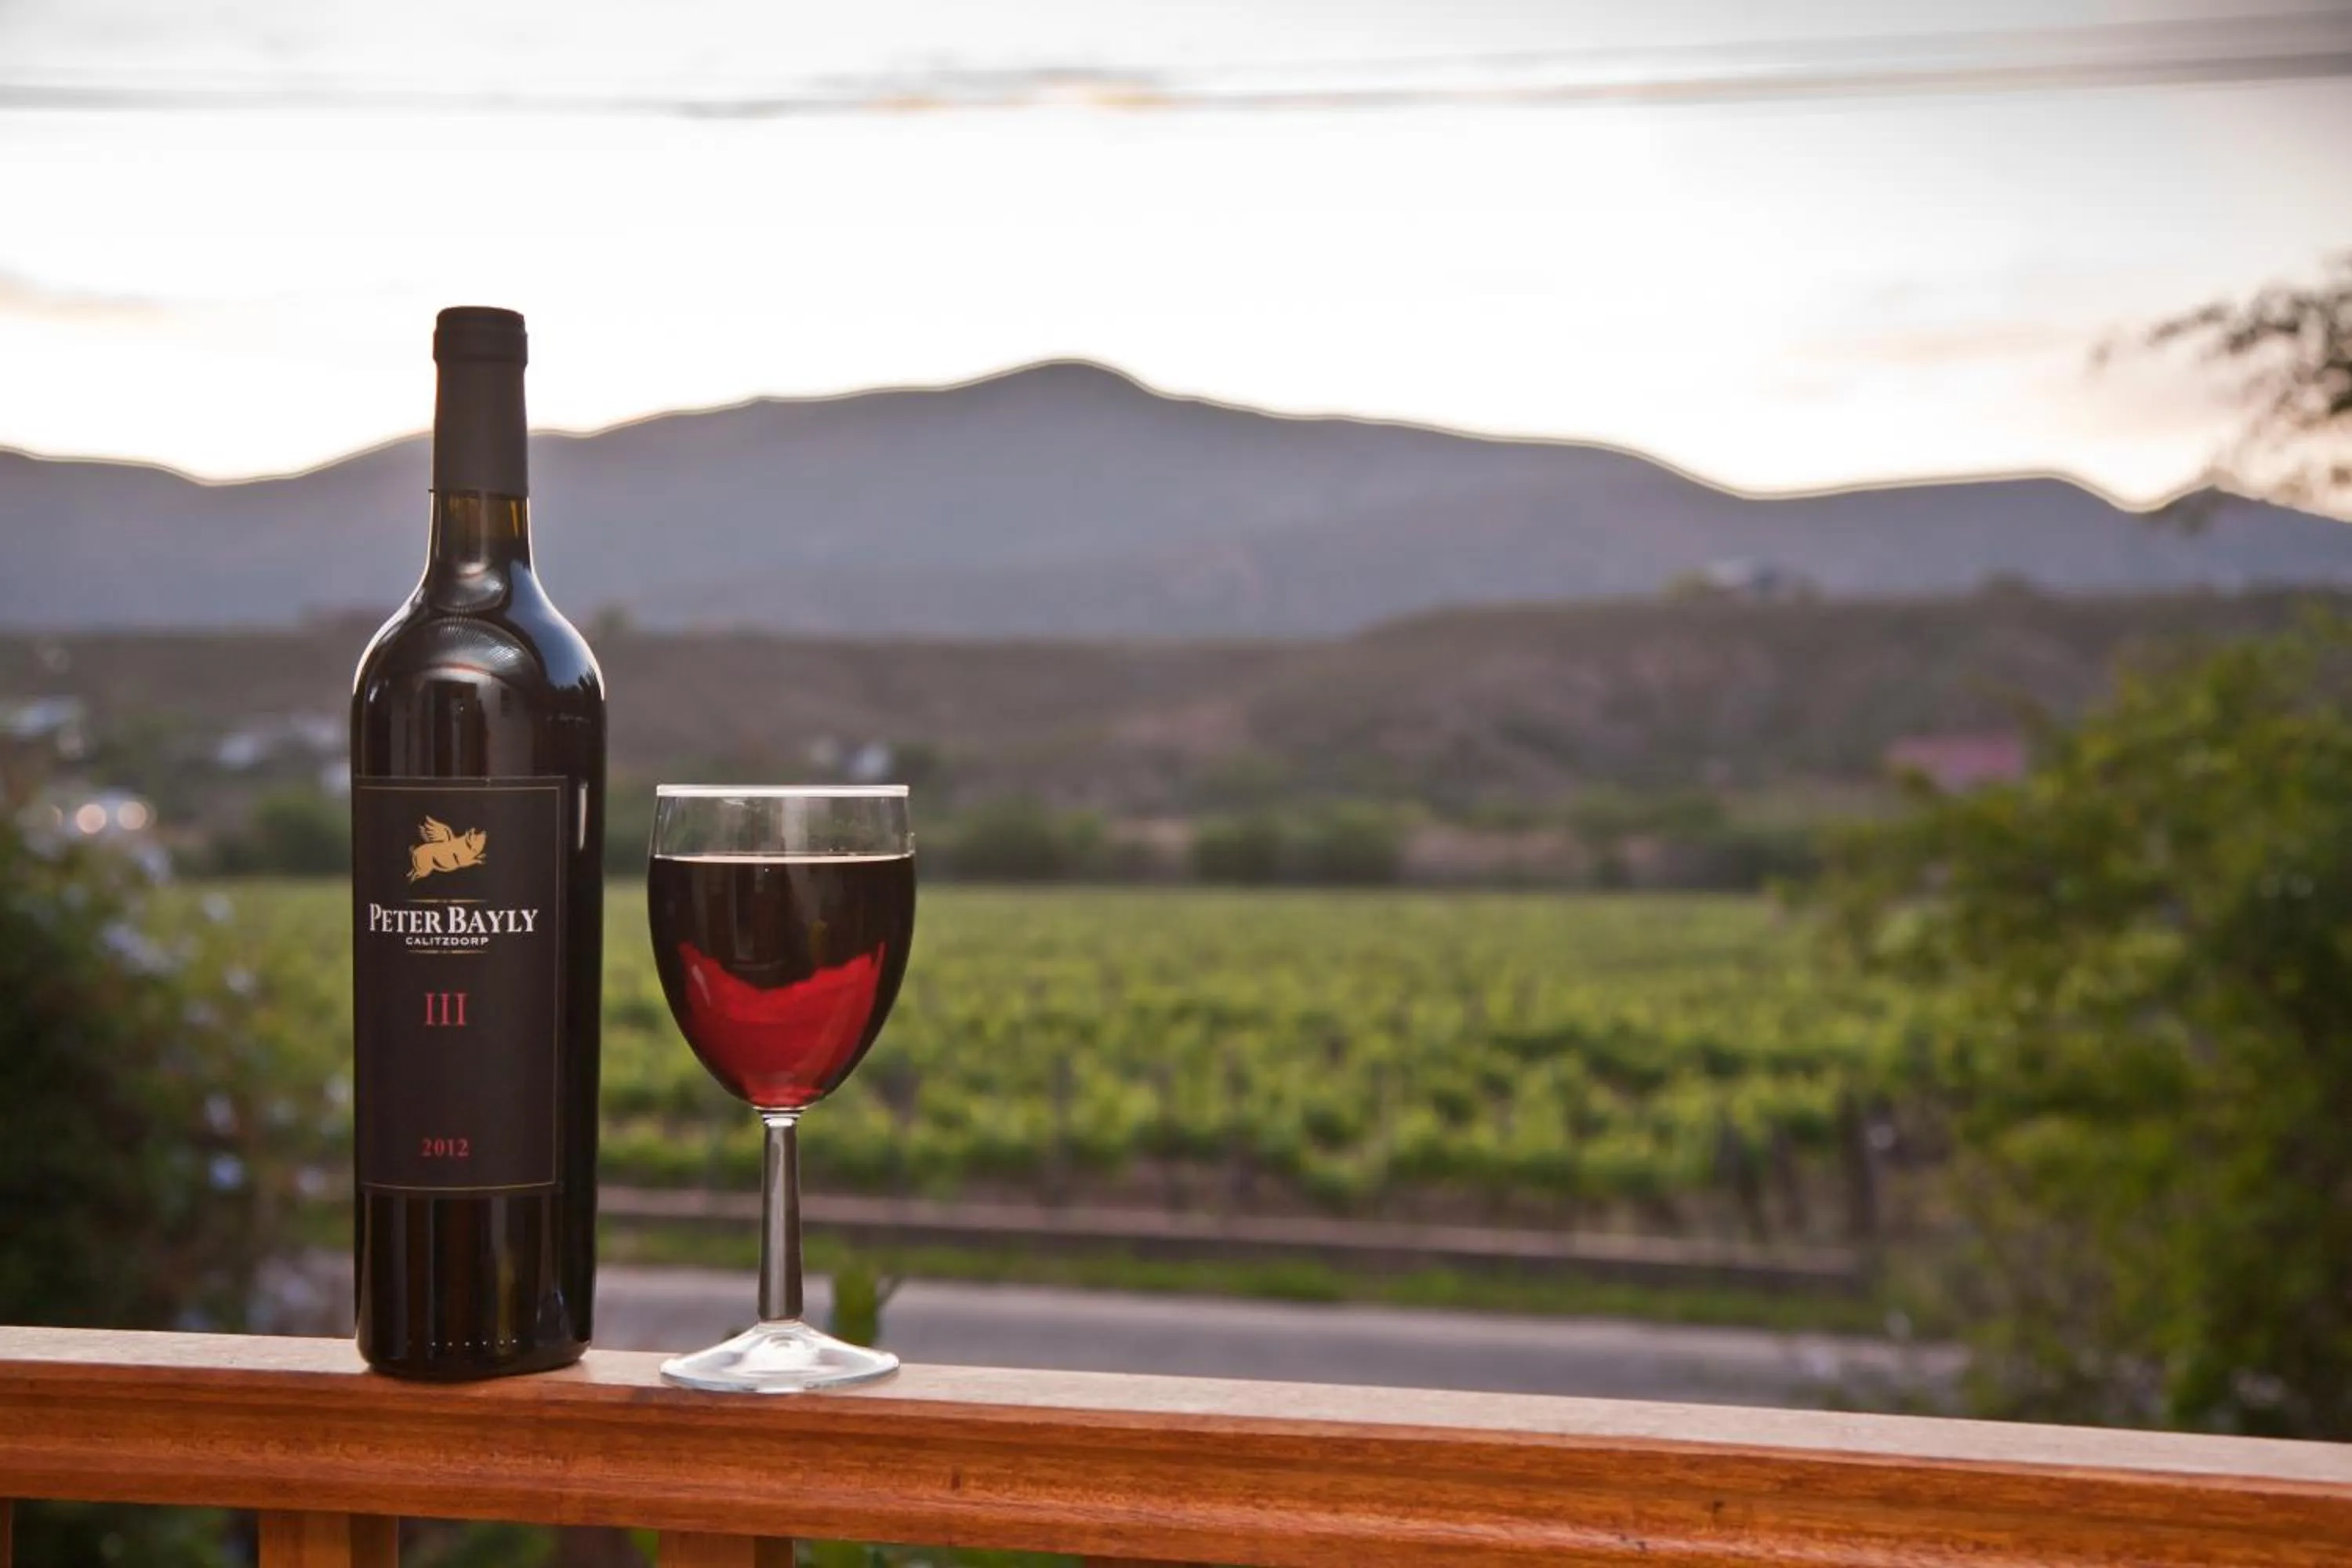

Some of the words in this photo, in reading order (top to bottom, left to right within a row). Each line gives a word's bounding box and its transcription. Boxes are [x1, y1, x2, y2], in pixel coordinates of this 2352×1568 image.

[405, 937, 489, 946] CALITZDORP
[425, 993, 467, 1026] III
[422, 1138, 470, 1156] 2012
